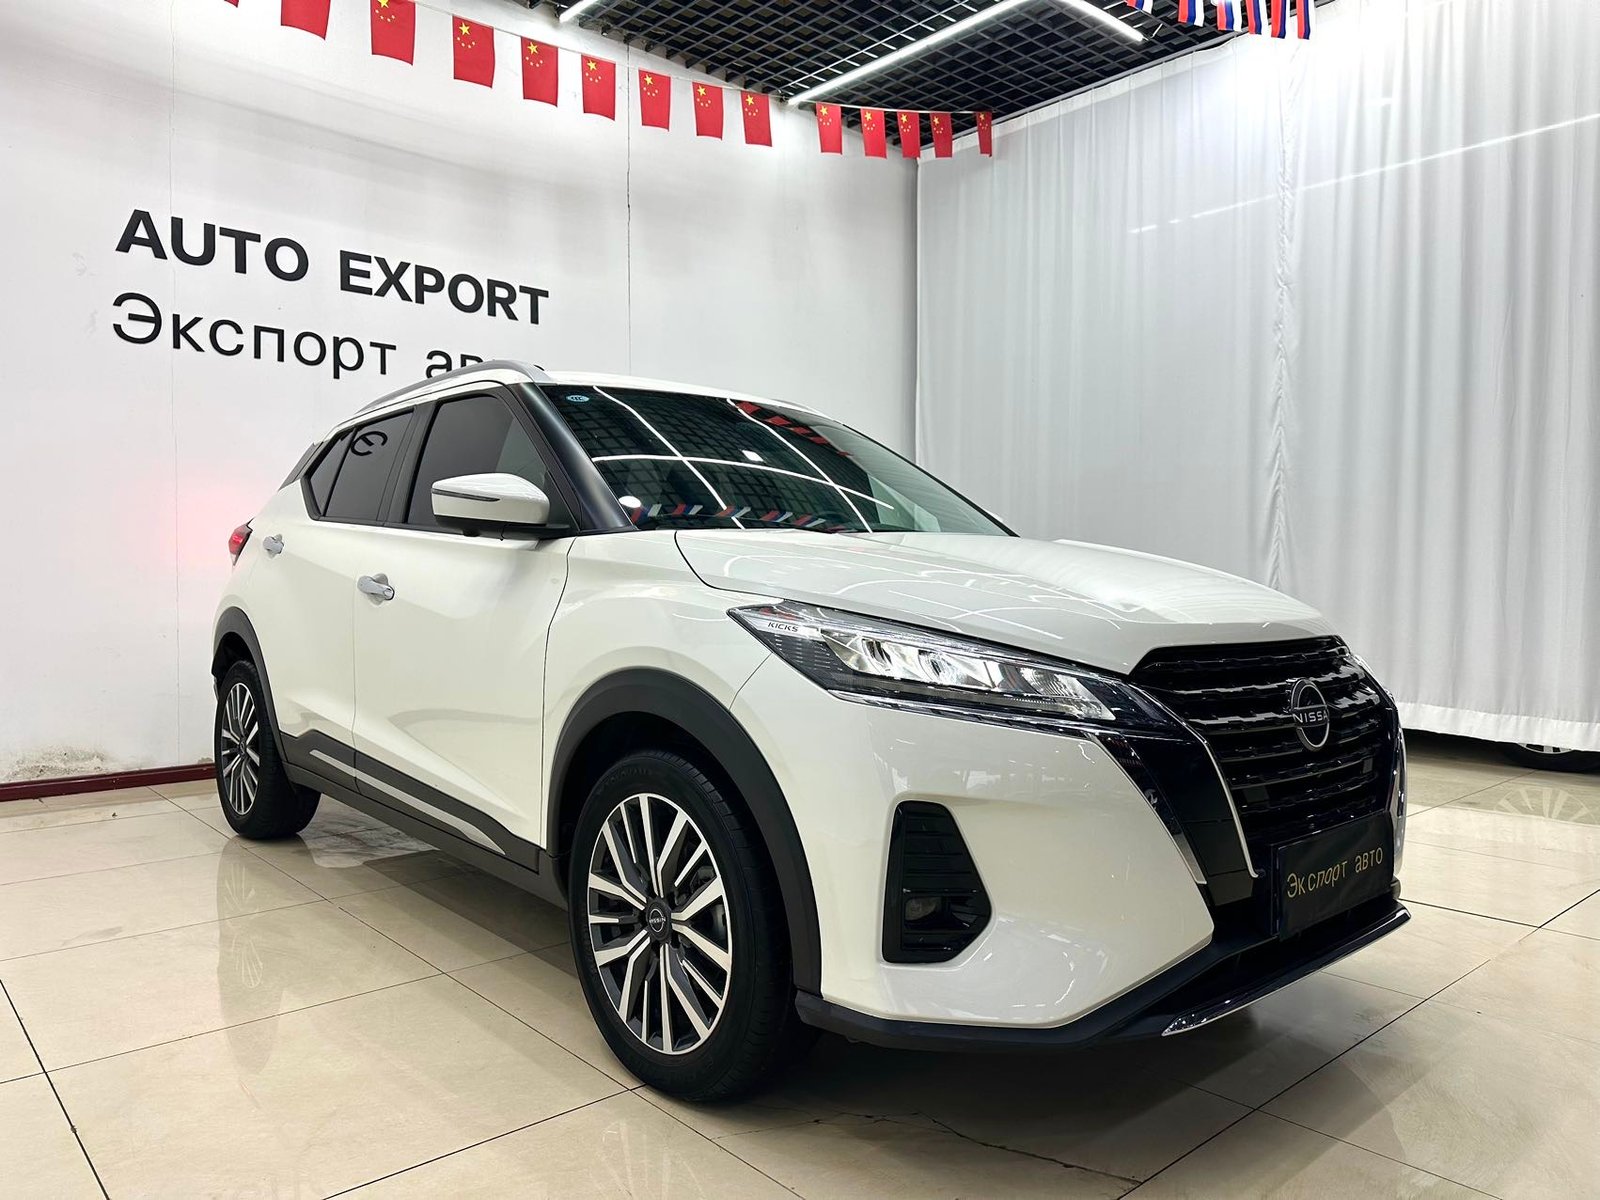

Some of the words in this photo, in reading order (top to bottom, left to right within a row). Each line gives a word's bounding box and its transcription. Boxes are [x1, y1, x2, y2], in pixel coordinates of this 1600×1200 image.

[115, 208, 309, 282] AUTO
[339, 249, 550, 325] EXPORT
[112, 292, 397, 380] Экспорт
[767, 621, 799, 633] KICKS
[1292, 710, 1328, 723] NISSA
[1286, 860, 1348, 898] Экспорт
[1354, 847, 1383, 874] авто
